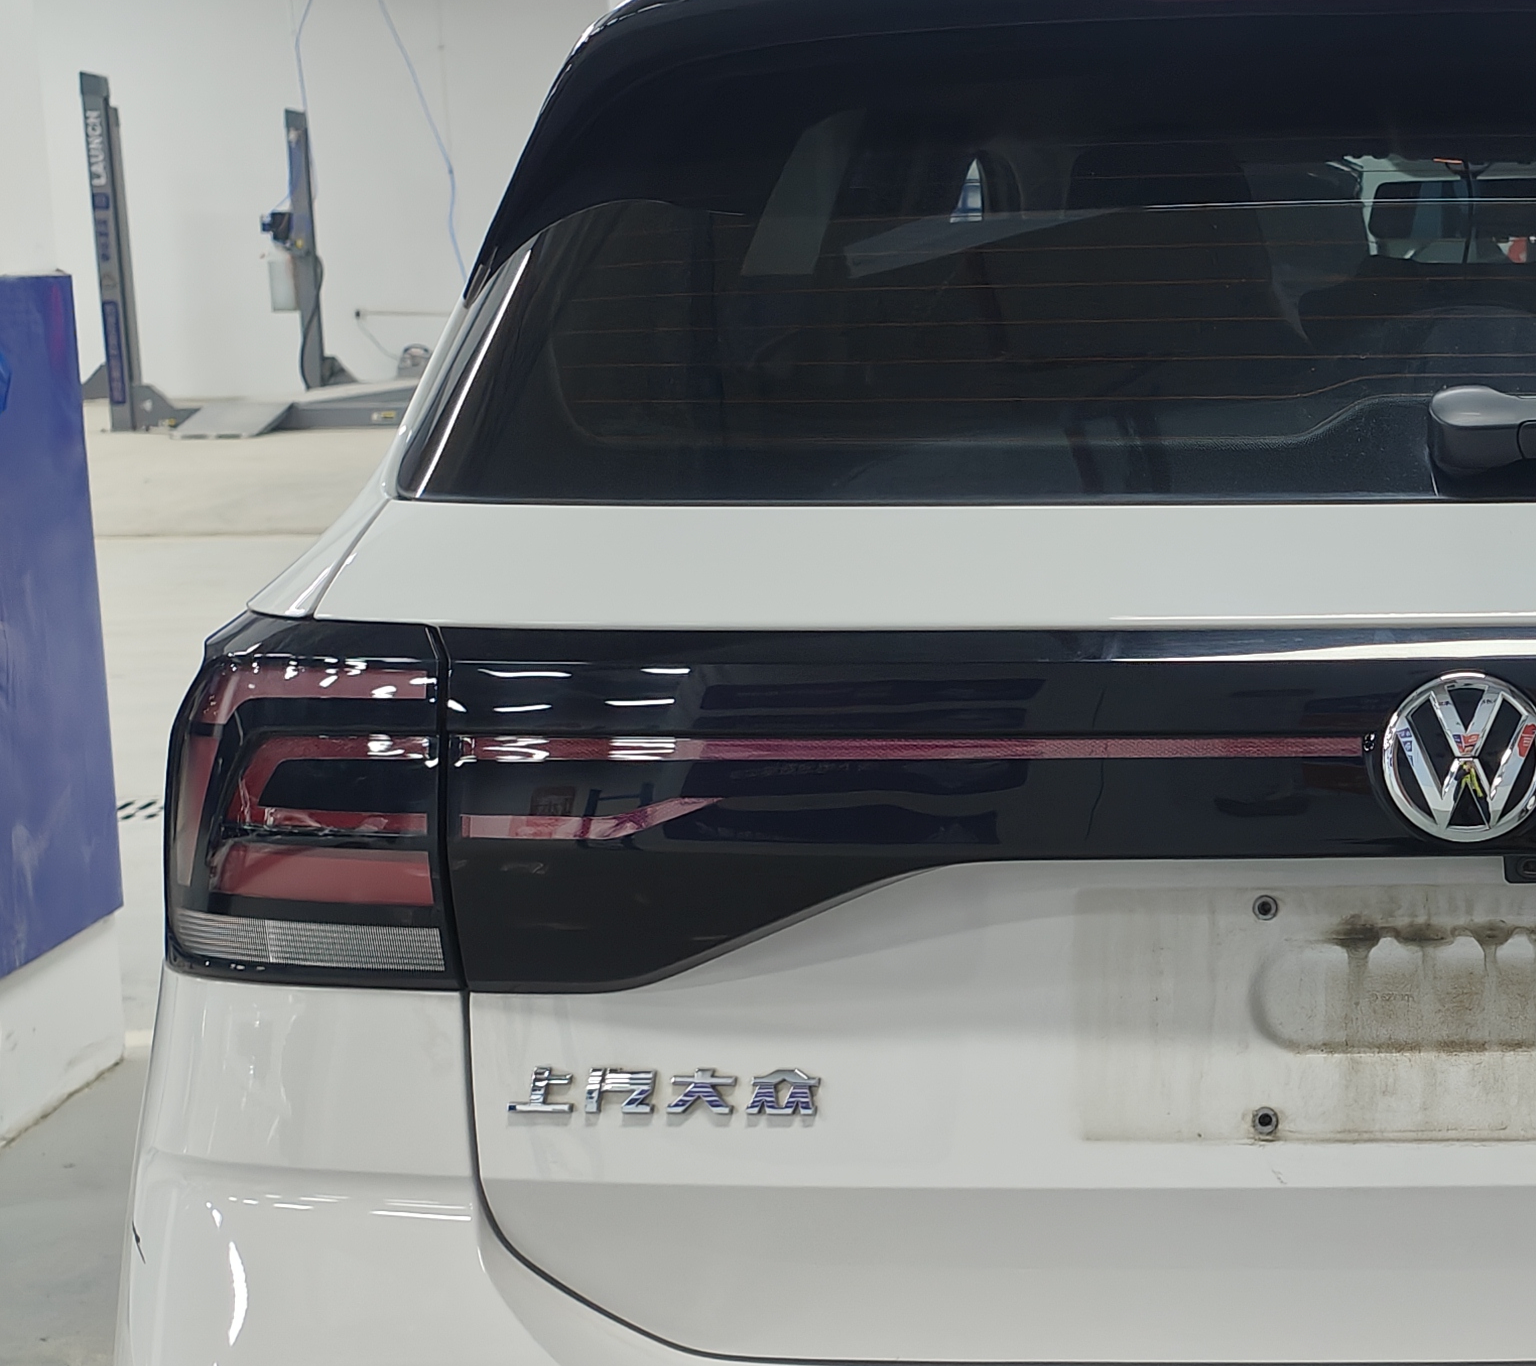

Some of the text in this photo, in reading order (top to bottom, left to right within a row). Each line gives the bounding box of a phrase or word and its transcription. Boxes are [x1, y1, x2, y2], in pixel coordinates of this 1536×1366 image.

[86, 110, 107, 186] LAUNCH
[507, 1066, 821, 1115] 上汽大众
